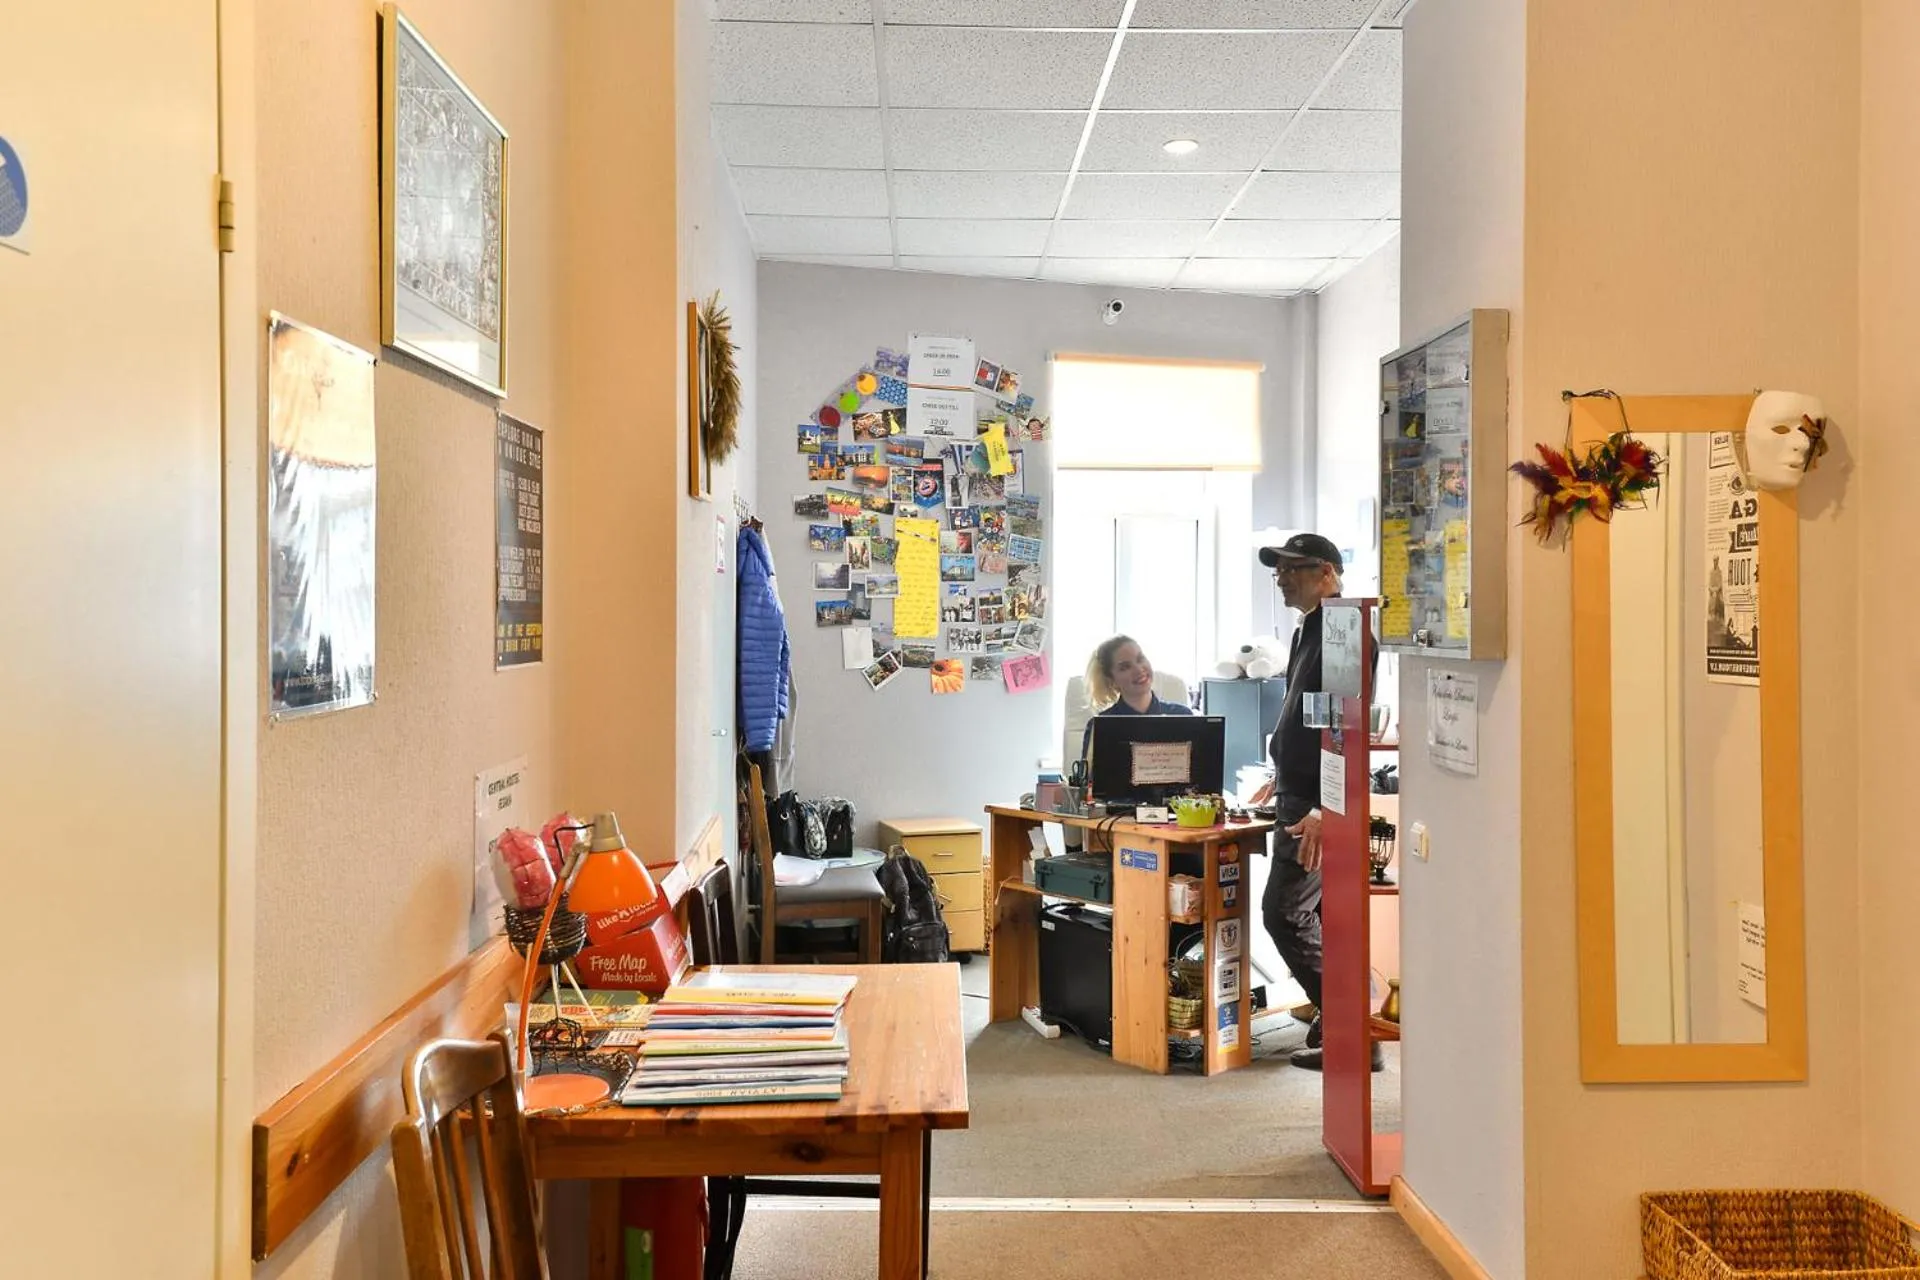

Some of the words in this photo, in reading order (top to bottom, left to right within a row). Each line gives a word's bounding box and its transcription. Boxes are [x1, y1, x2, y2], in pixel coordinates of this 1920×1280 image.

[1222, 867, 1238, 879] VISA
[589, 955, 617, 971] Free
[619, 953, 647, 973] Map
[601, 972, 623, 982] Made
[624, 973, 633, 984] by
[634, 972, 657, 983] Locals
